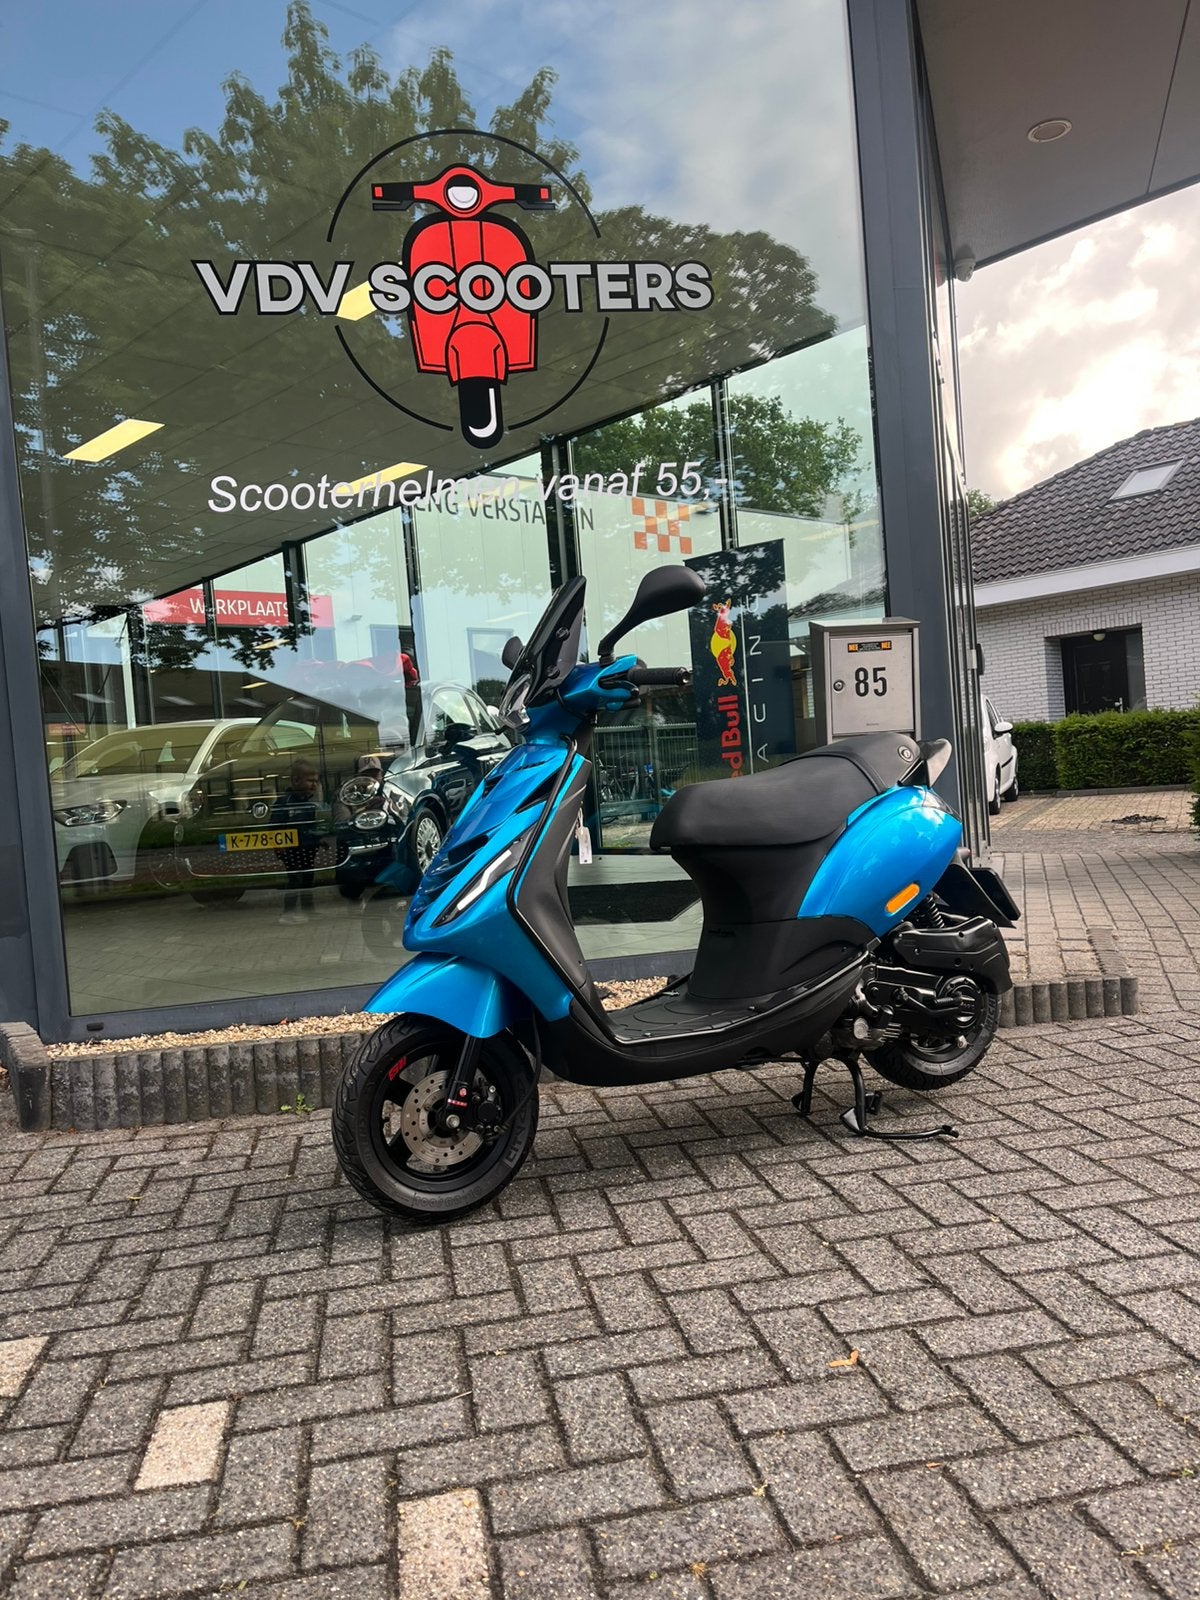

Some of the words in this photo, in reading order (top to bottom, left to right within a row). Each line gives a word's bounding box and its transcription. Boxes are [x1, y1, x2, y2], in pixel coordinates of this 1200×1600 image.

[192, 260, 354, 315] VDV
[368, 261, 713, 313] SCOOTERS
[207, 469, 520, 513] Scooterhelmen
[537, 462, 646, 501] vanaf
[189, 597, 289, 617] WRKPLAATS
[855, 667, 887, 697] 85
[718, 695, 742, 748] Bull
[231, 831, 294, 849] K-778-GN
